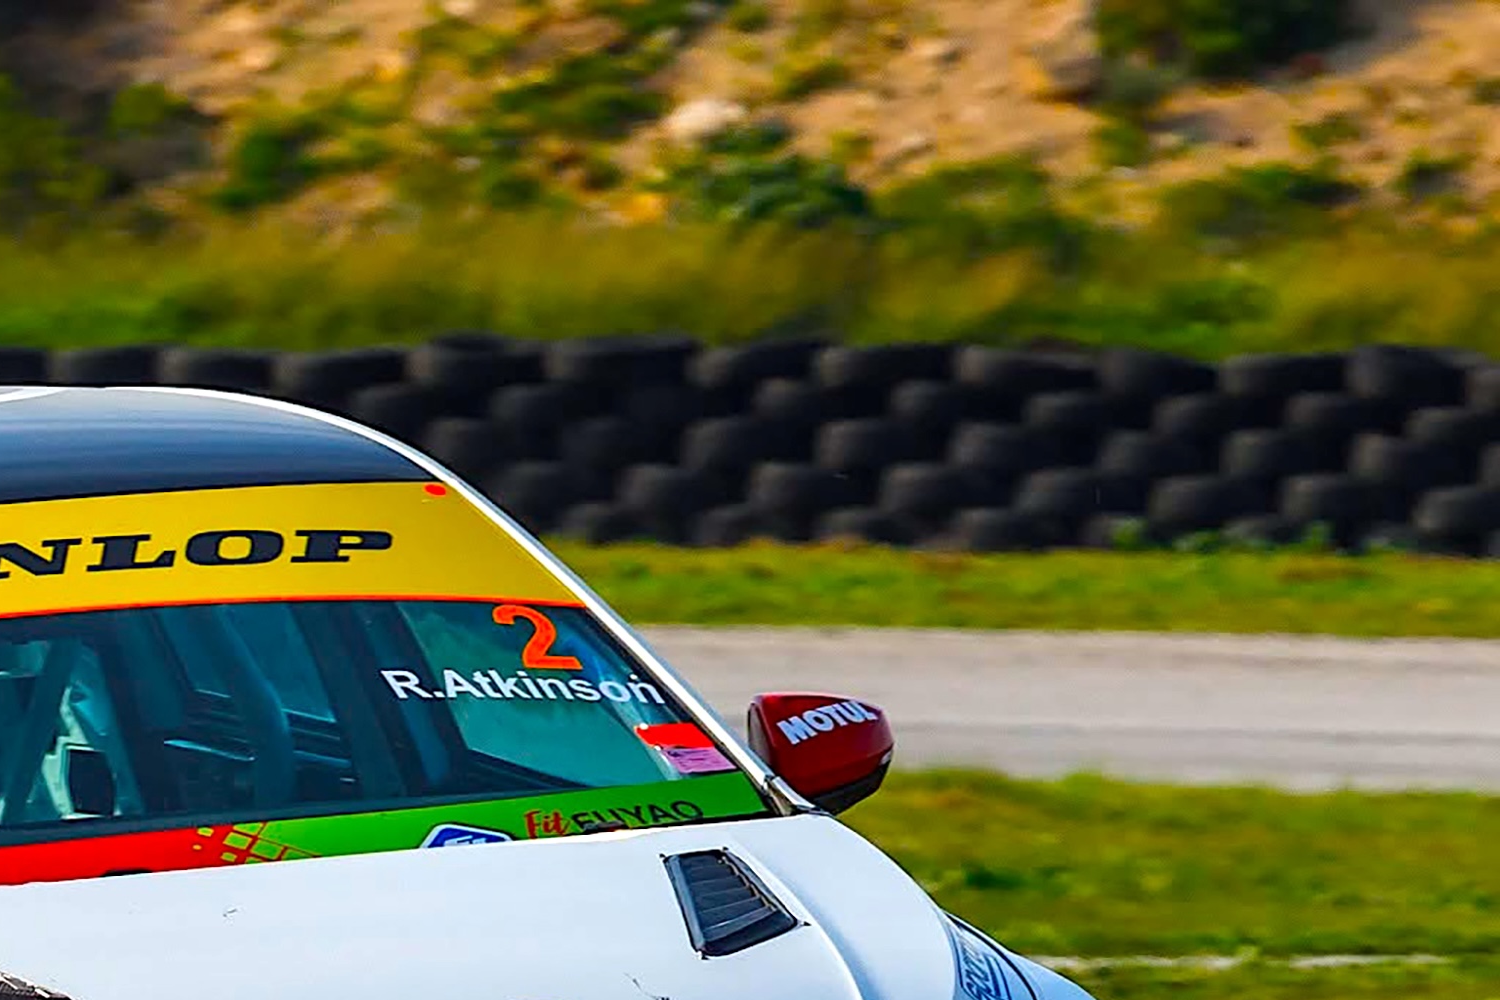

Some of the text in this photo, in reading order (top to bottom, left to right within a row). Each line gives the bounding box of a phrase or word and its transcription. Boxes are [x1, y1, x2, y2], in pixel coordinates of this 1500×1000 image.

[493, 604, 583, 669] 2
[381, 667, 666, 704] R.Atkinson
[776, 700, 878, 745] MOTUL
